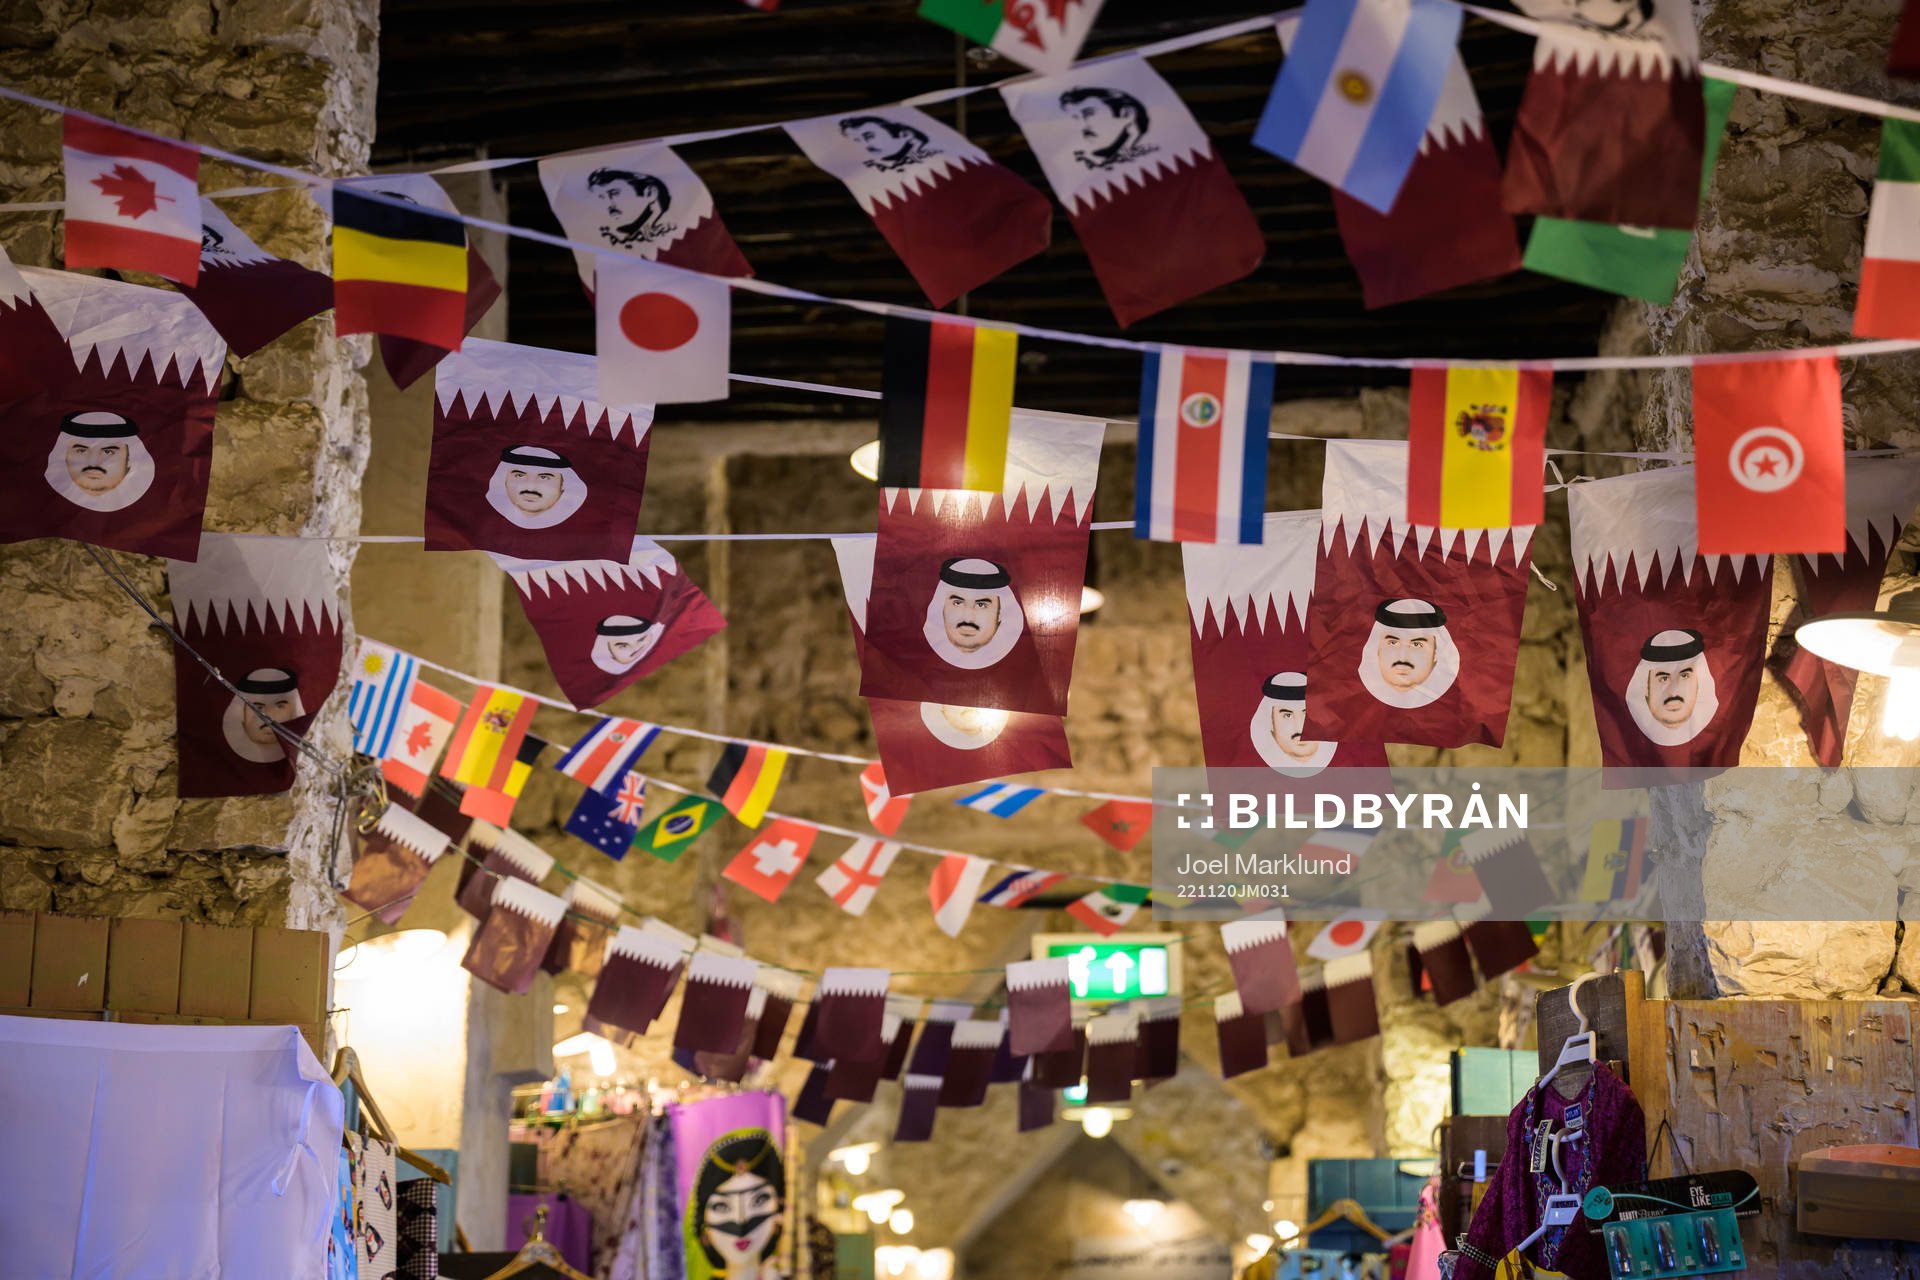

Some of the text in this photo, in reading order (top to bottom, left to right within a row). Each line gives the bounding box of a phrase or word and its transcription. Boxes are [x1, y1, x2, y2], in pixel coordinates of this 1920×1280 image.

[1689, 1186, 1704, 1197] EYE
[1691, 1194, 1712, 1208] LIKE
[1619, 1210, 1638, 1221] BEAUTY
